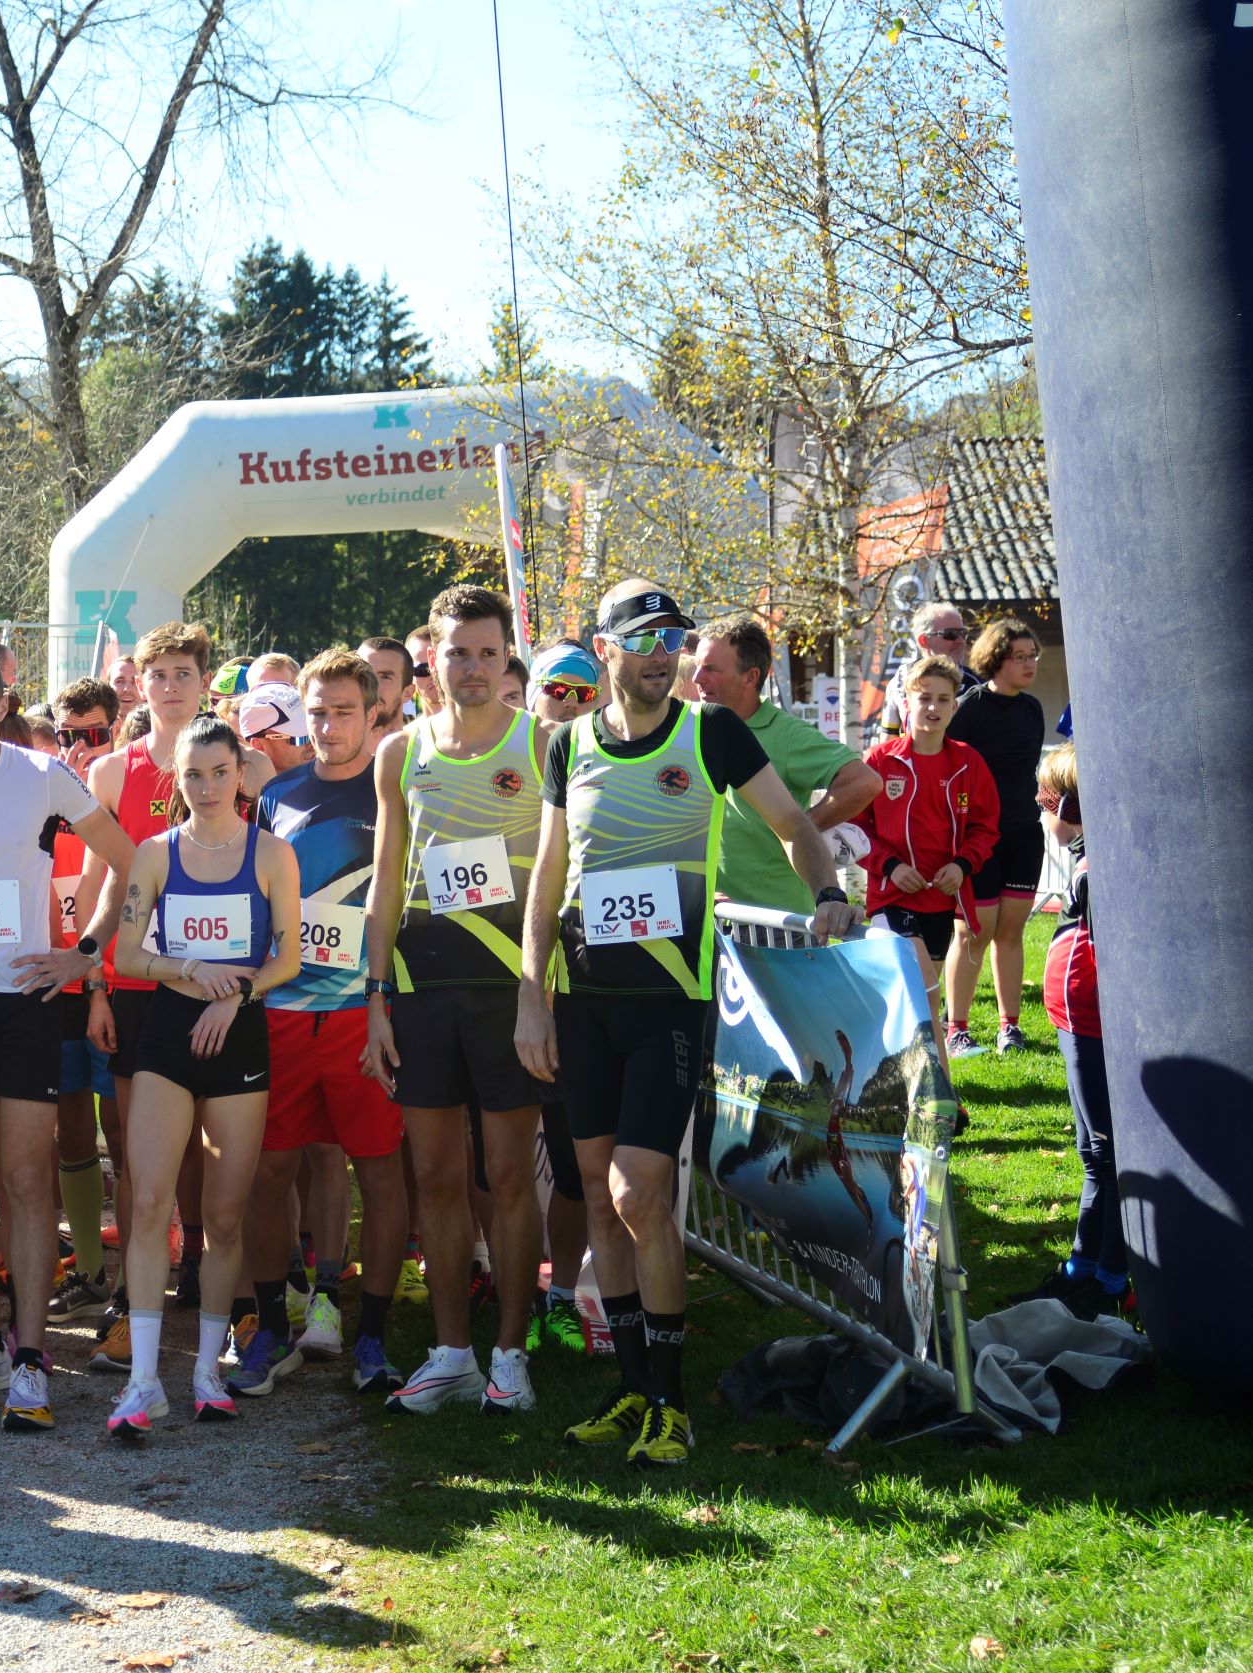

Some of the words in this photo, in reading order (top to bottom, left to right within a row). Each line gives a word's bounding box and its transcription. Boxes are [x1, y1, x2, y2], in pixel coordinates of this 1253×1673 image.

[346, 484, 447, 506] verbindet
[56, 760, 92, 799] salomon
[440, 863, 488, 892] 196
[601, 893, 656, 922] 235
[183, 917, 229, 941] 605
[300, 921, 341, 948] 208
[609, 1310, 645, 1327] cep
